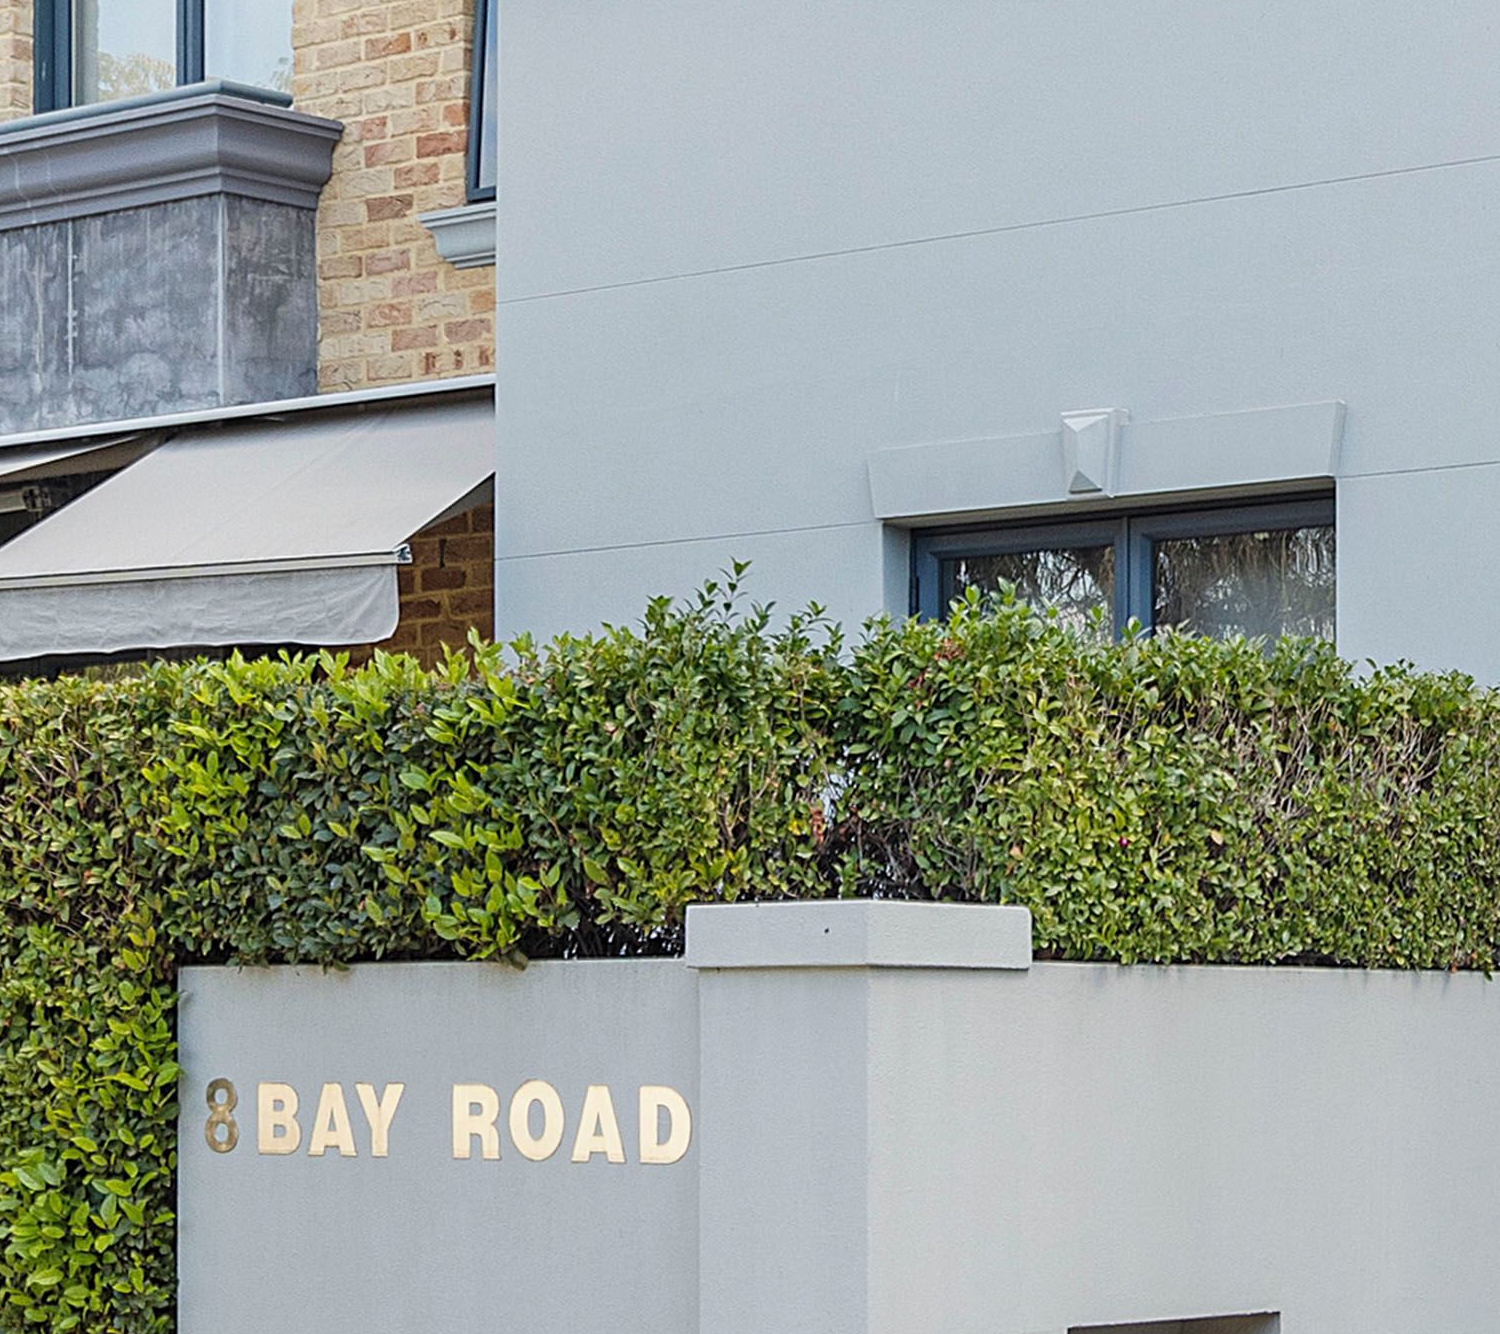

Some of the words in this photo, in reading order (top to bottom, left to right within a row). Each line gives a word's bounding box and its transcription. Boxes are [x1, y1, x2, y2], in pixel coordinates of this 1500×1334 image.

[204, 1077, 239, 1155] 8
[256, 1081, 405, 1158] BAY
[452, 1078, 693, 1165] ROAD
